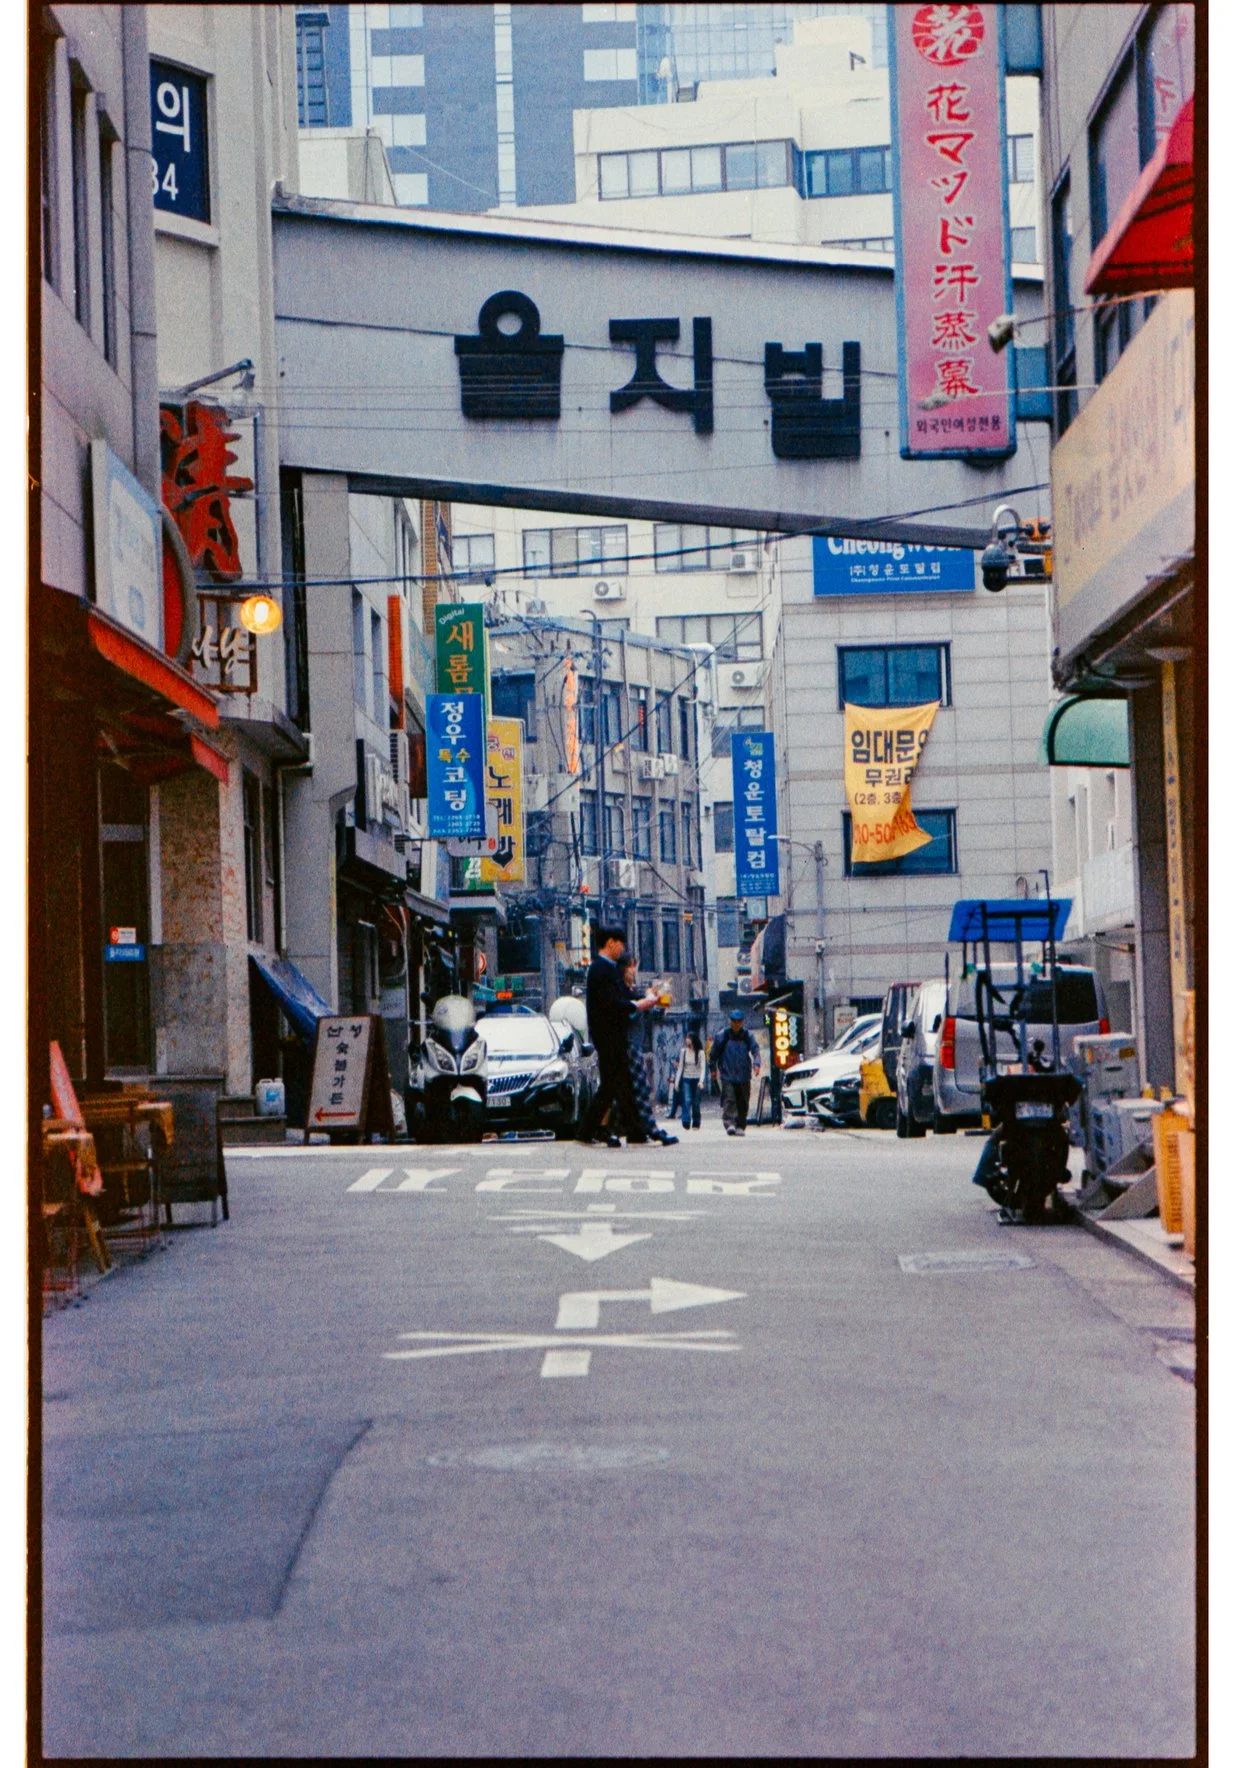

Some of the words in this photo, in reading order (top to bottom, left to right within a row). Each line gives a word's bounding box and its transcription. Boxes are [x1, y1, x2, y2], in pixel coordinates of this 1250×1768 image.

[155, 81, 191, 153] 의
[925, 81, 983, 397] 花マッド汗蒸幕
[915, 412, 1003, 434] 외국인여성전용
[439, 607, 465, 625] Digital
[441, 701, 466, 746] 정우
[438, 747, 471, 764] 특수
[442, 766, 468, 812] 코팅
[743, 759, 768, 870] 청운토탈컴
[775, 1008, 790, 1066] SHOT
[345, 1168, 783, 1197] 진입금지
